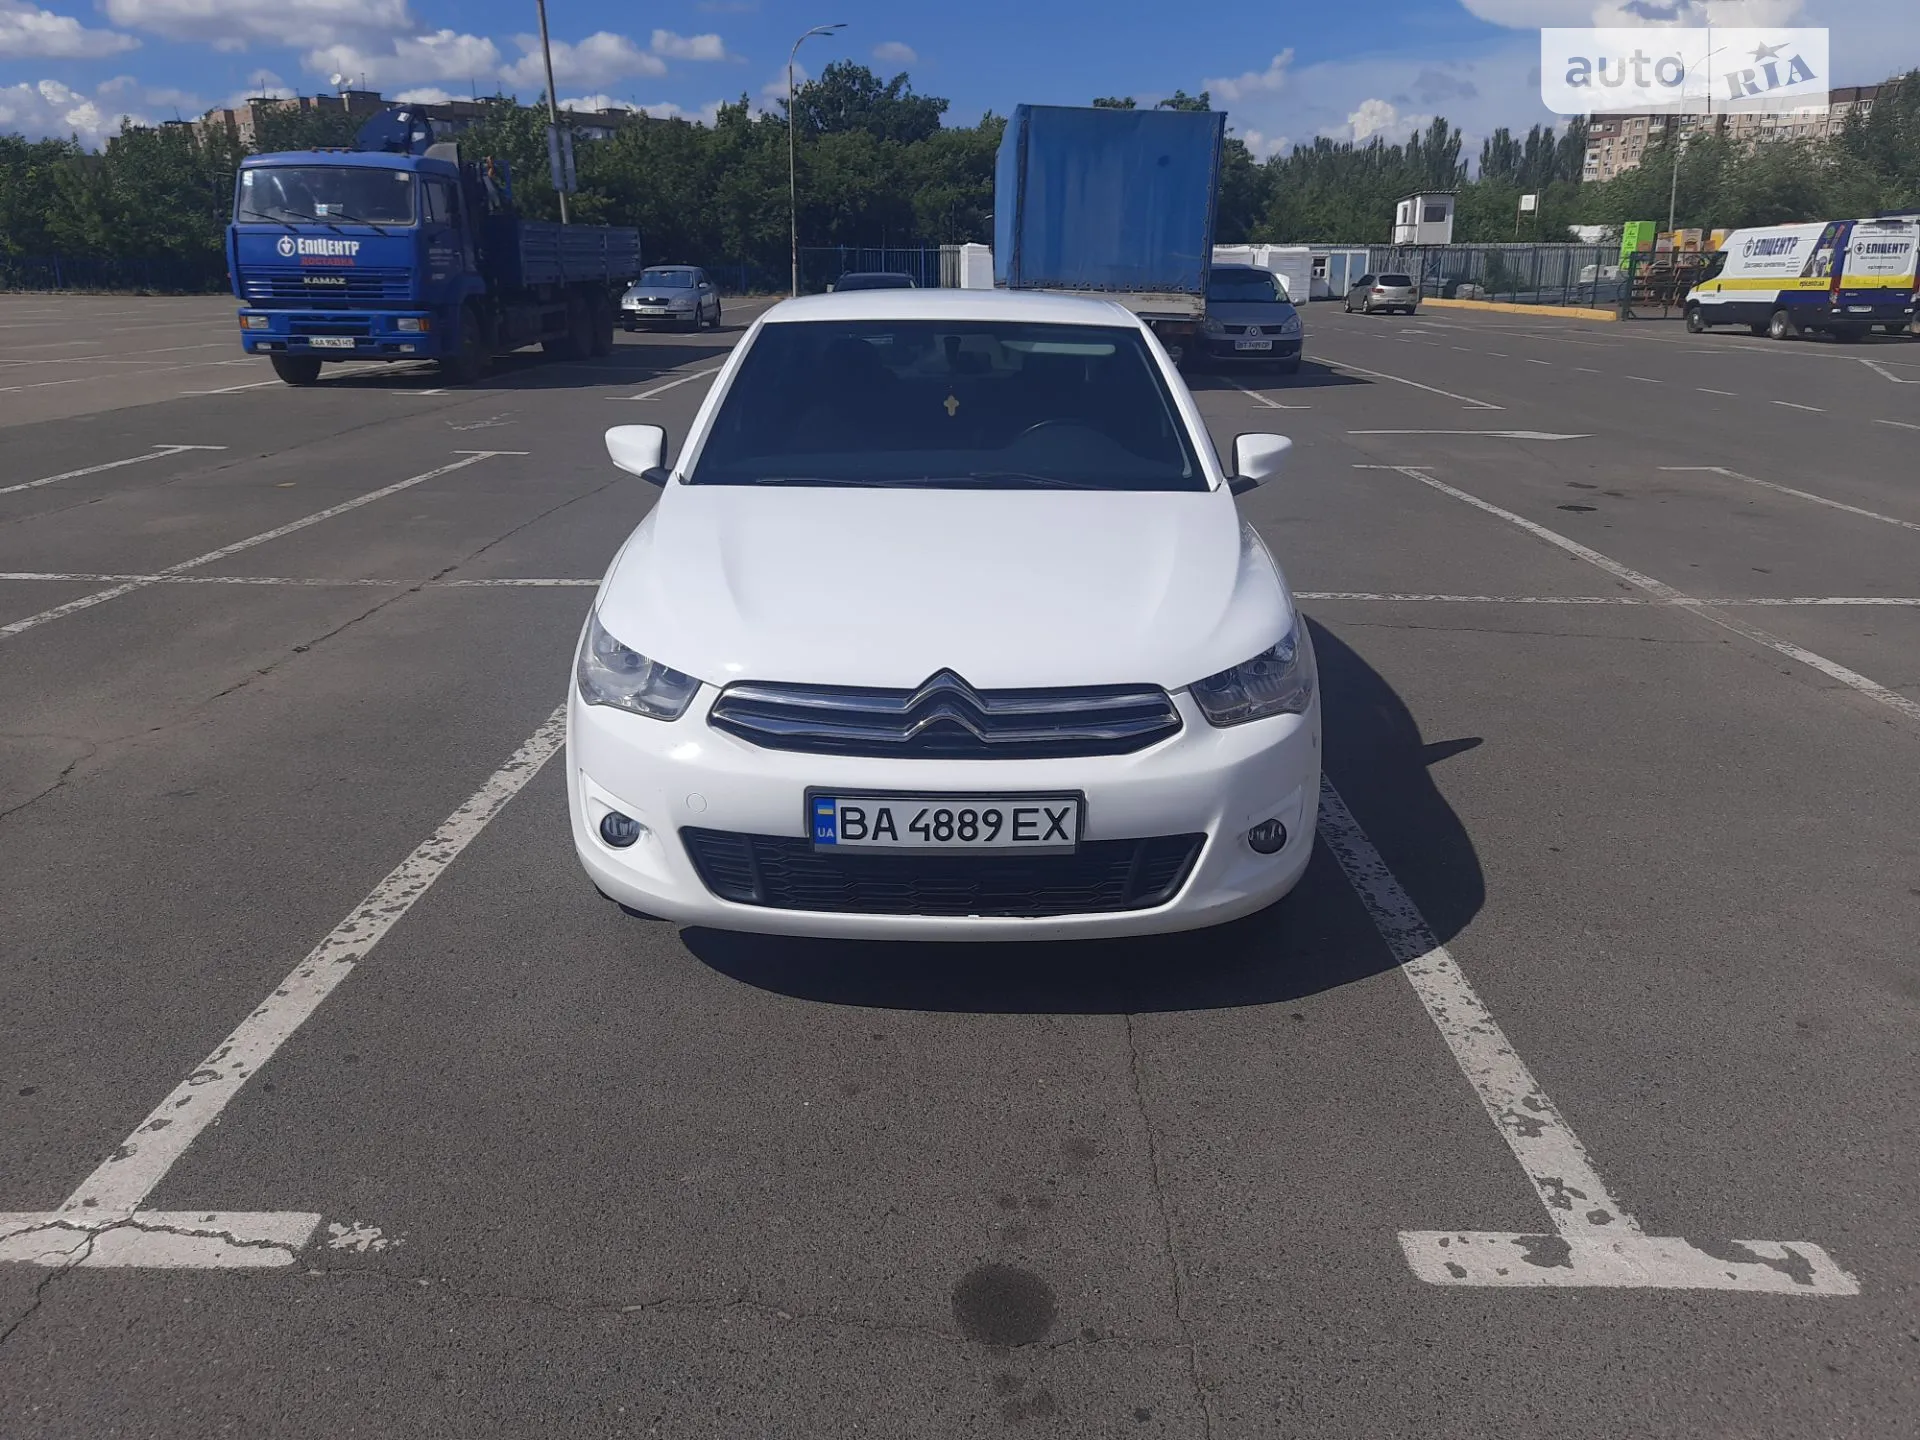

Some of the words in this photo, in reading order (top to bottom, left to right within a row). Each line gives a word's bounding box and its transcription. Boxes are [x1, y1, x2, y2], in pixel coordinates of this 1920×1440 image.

[1866, 243, 1910, 254] ЕПІЦЕНТР
[303, 277, 347, 285] KAMAZ
[840, 806, 898, 841] BA
[908, 808, 1003, 842] 4889
[1012, 807, 1071, 841] EX
[818, 828, 834, 838] UA
